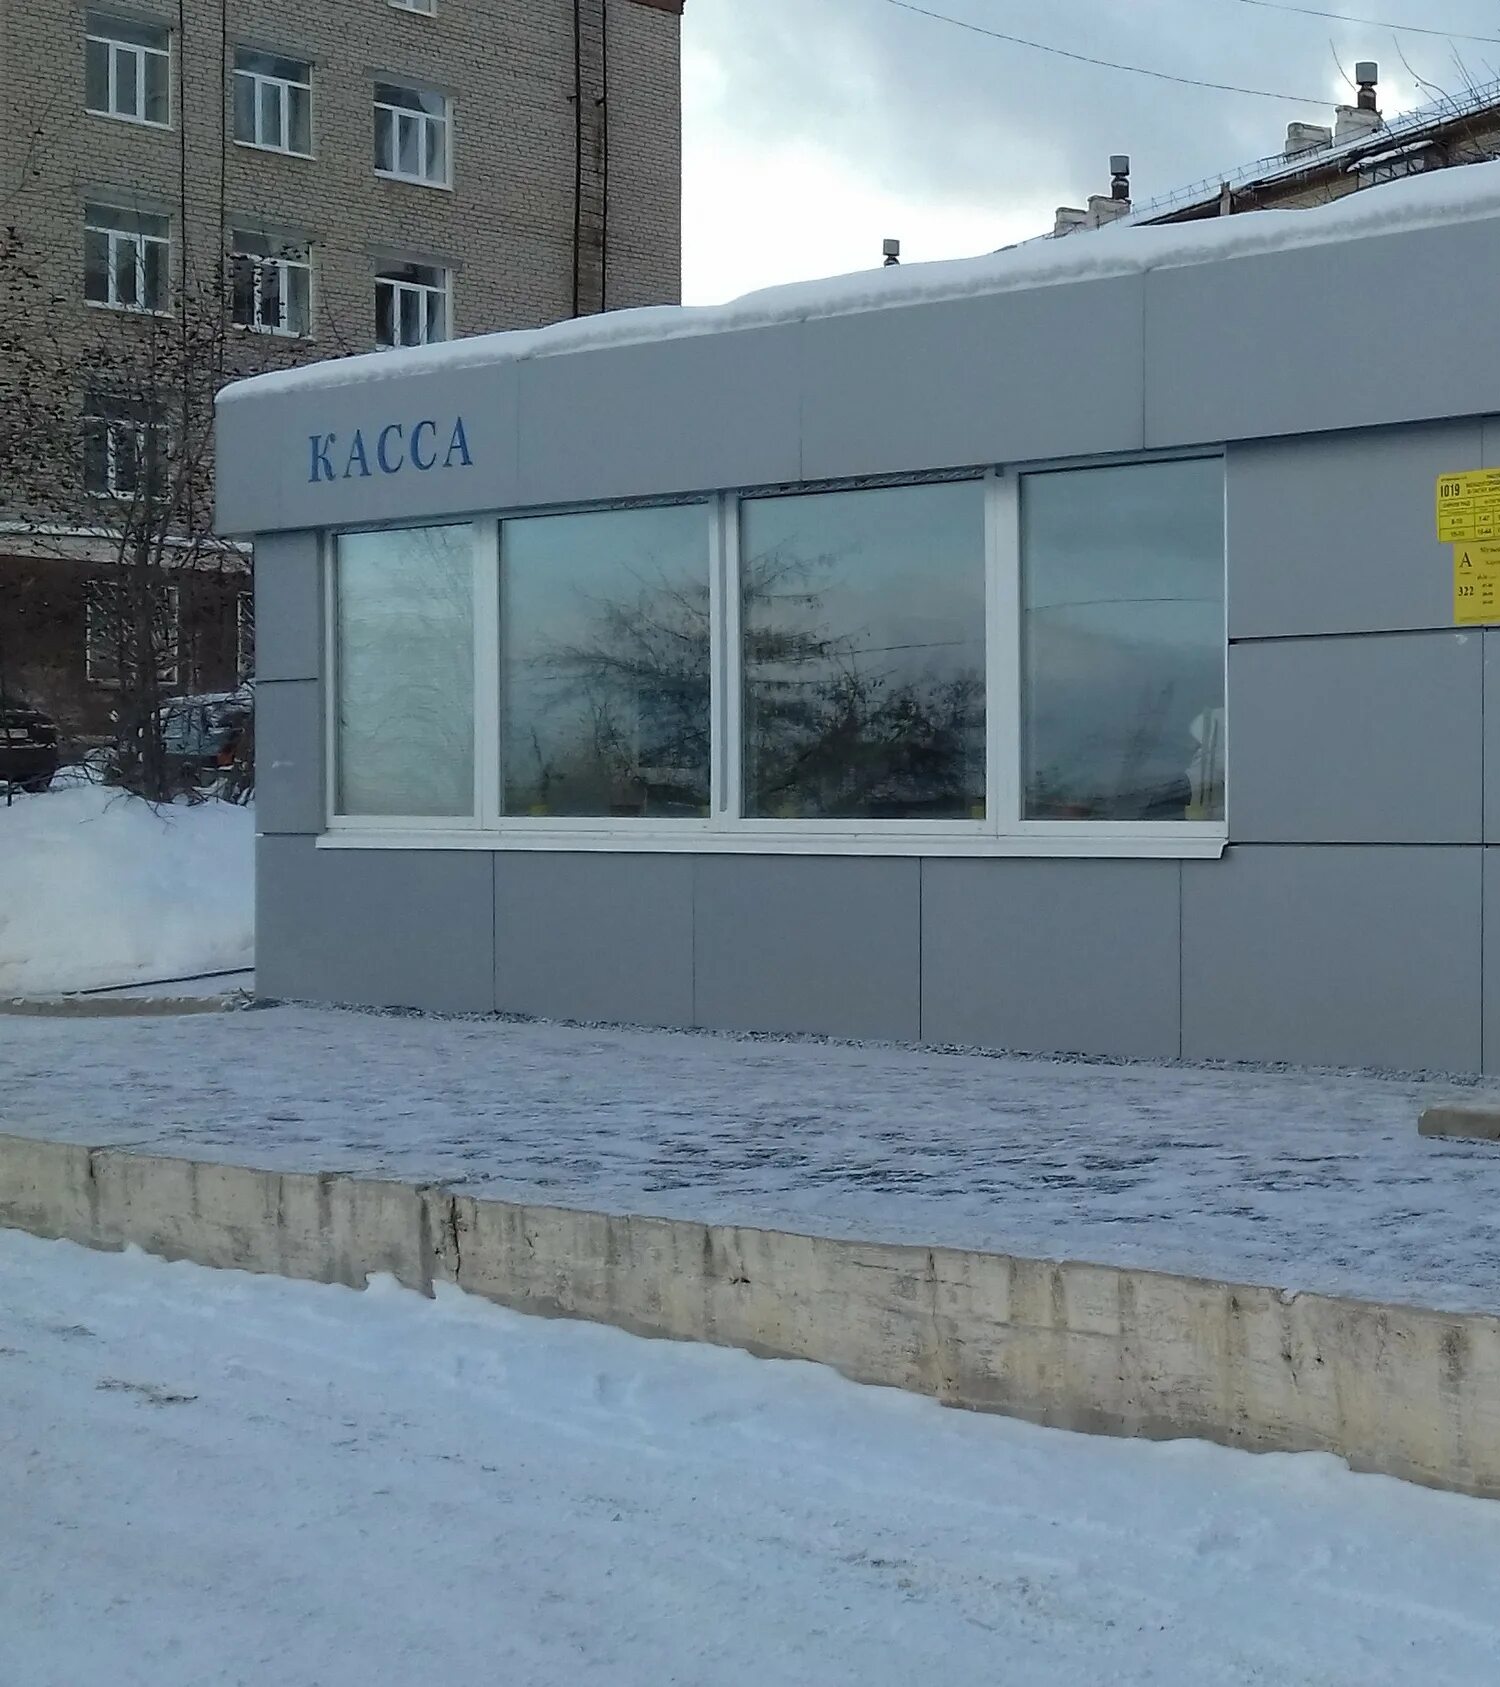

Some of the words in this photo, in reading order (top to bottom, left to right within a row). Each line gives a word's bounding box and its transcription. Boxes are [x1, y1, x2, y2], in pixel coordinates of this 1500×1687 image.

[308, 416, 473, 483] КАССА
[1440, 483, 1460, 497] 1019
[1459, 551, 1472, 568] А
[1458, 586, 1474, 597] 322
